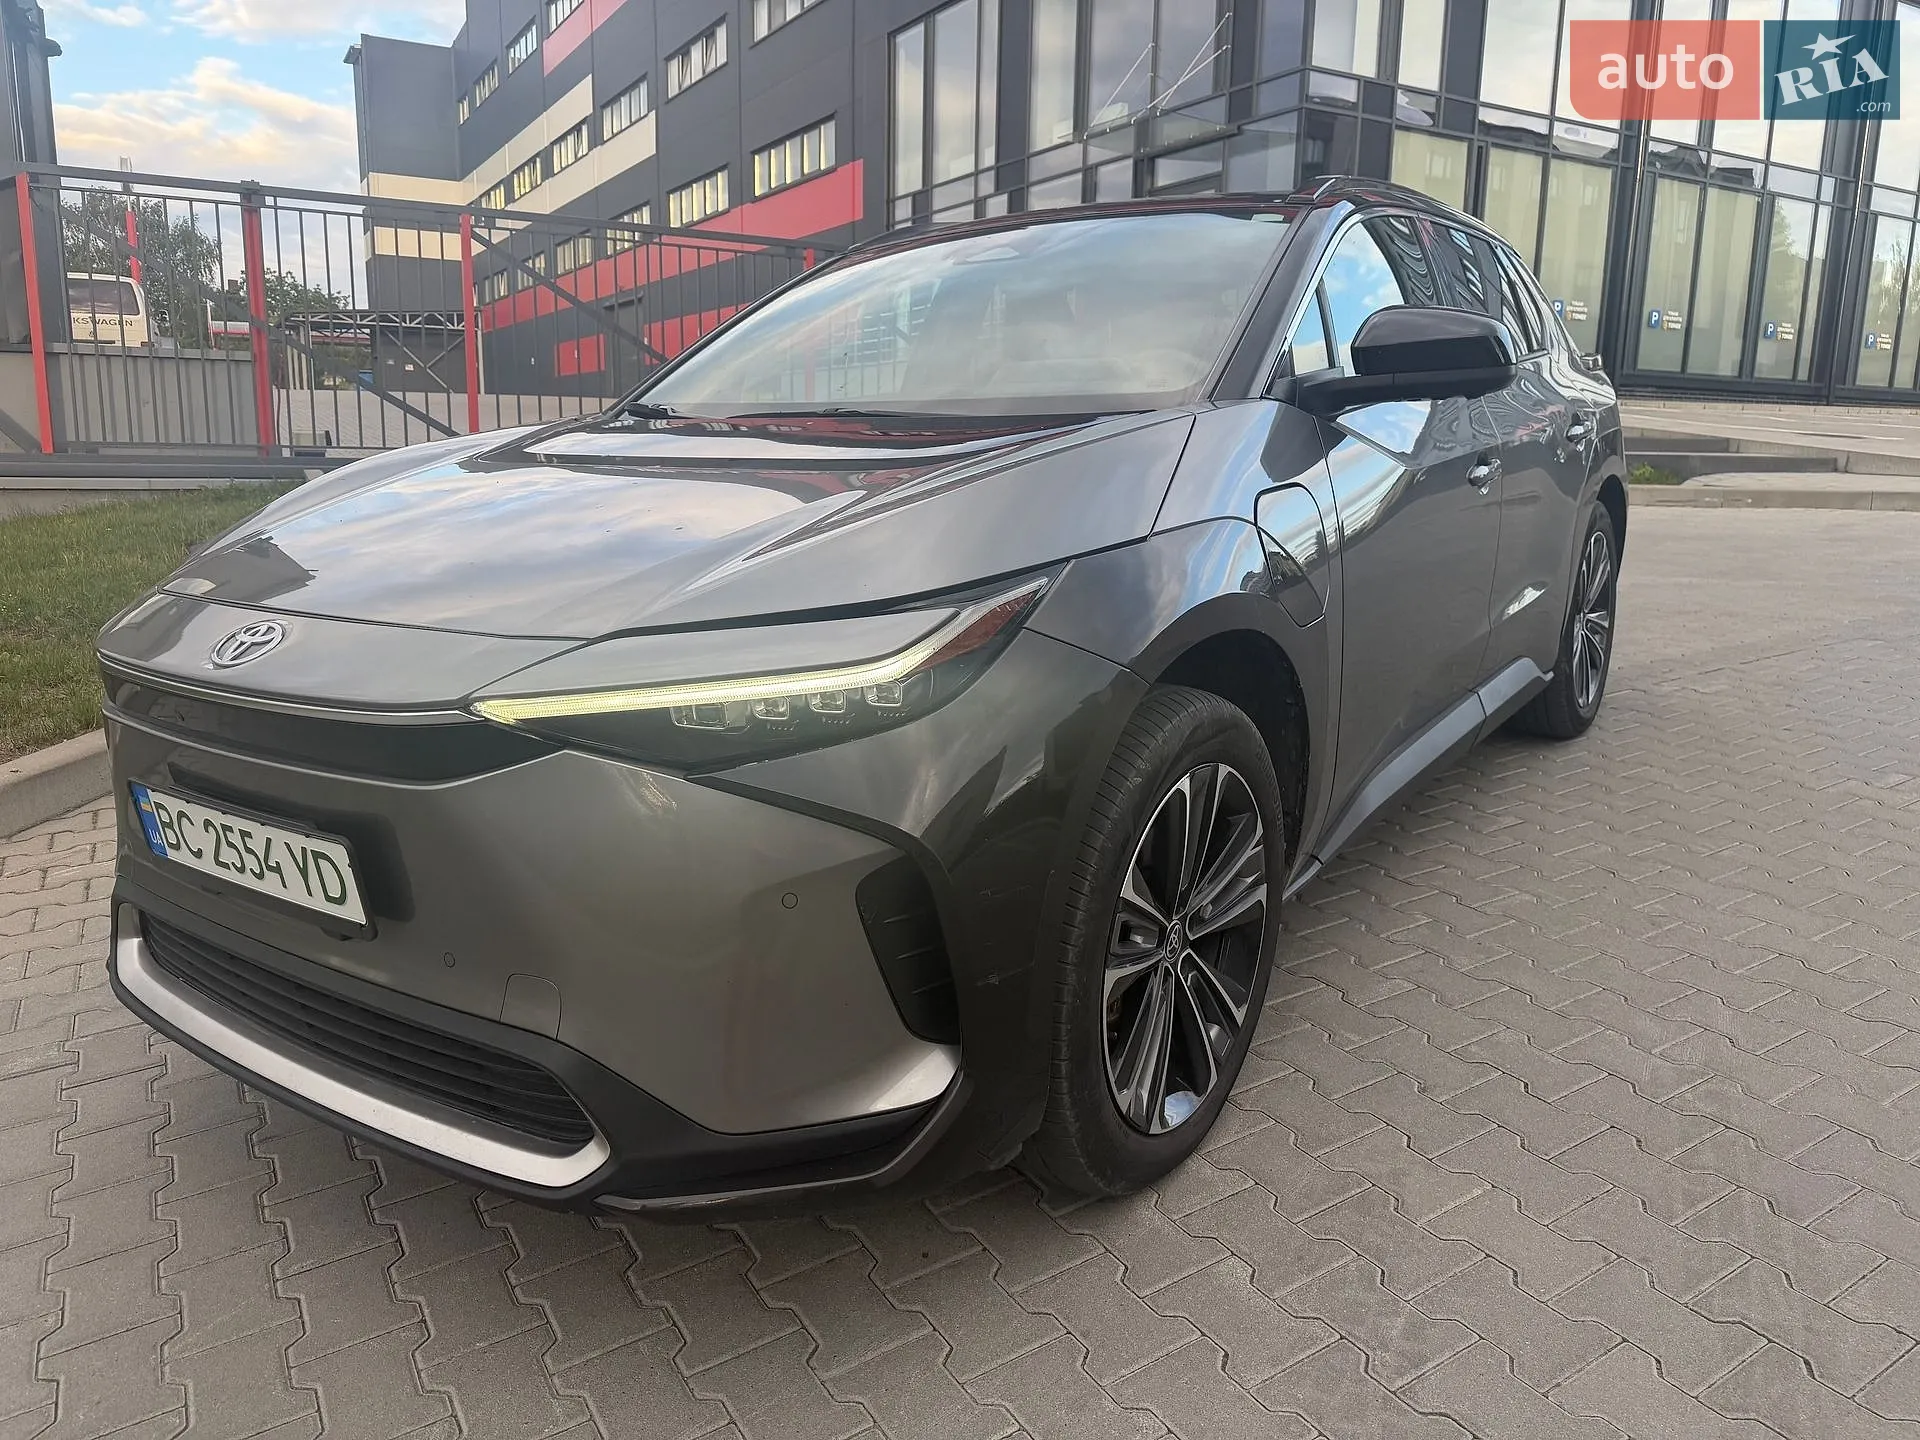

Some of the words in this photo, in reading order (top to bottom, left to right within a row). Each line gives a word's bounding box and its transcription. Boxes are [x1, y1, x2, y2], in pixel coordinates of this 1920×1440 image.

[148, 830, 163, 846] UA
[154, 801, 203, 859] BC
[203, 818, 288, 889] 2554
[284, 840, 348, 906] YD
